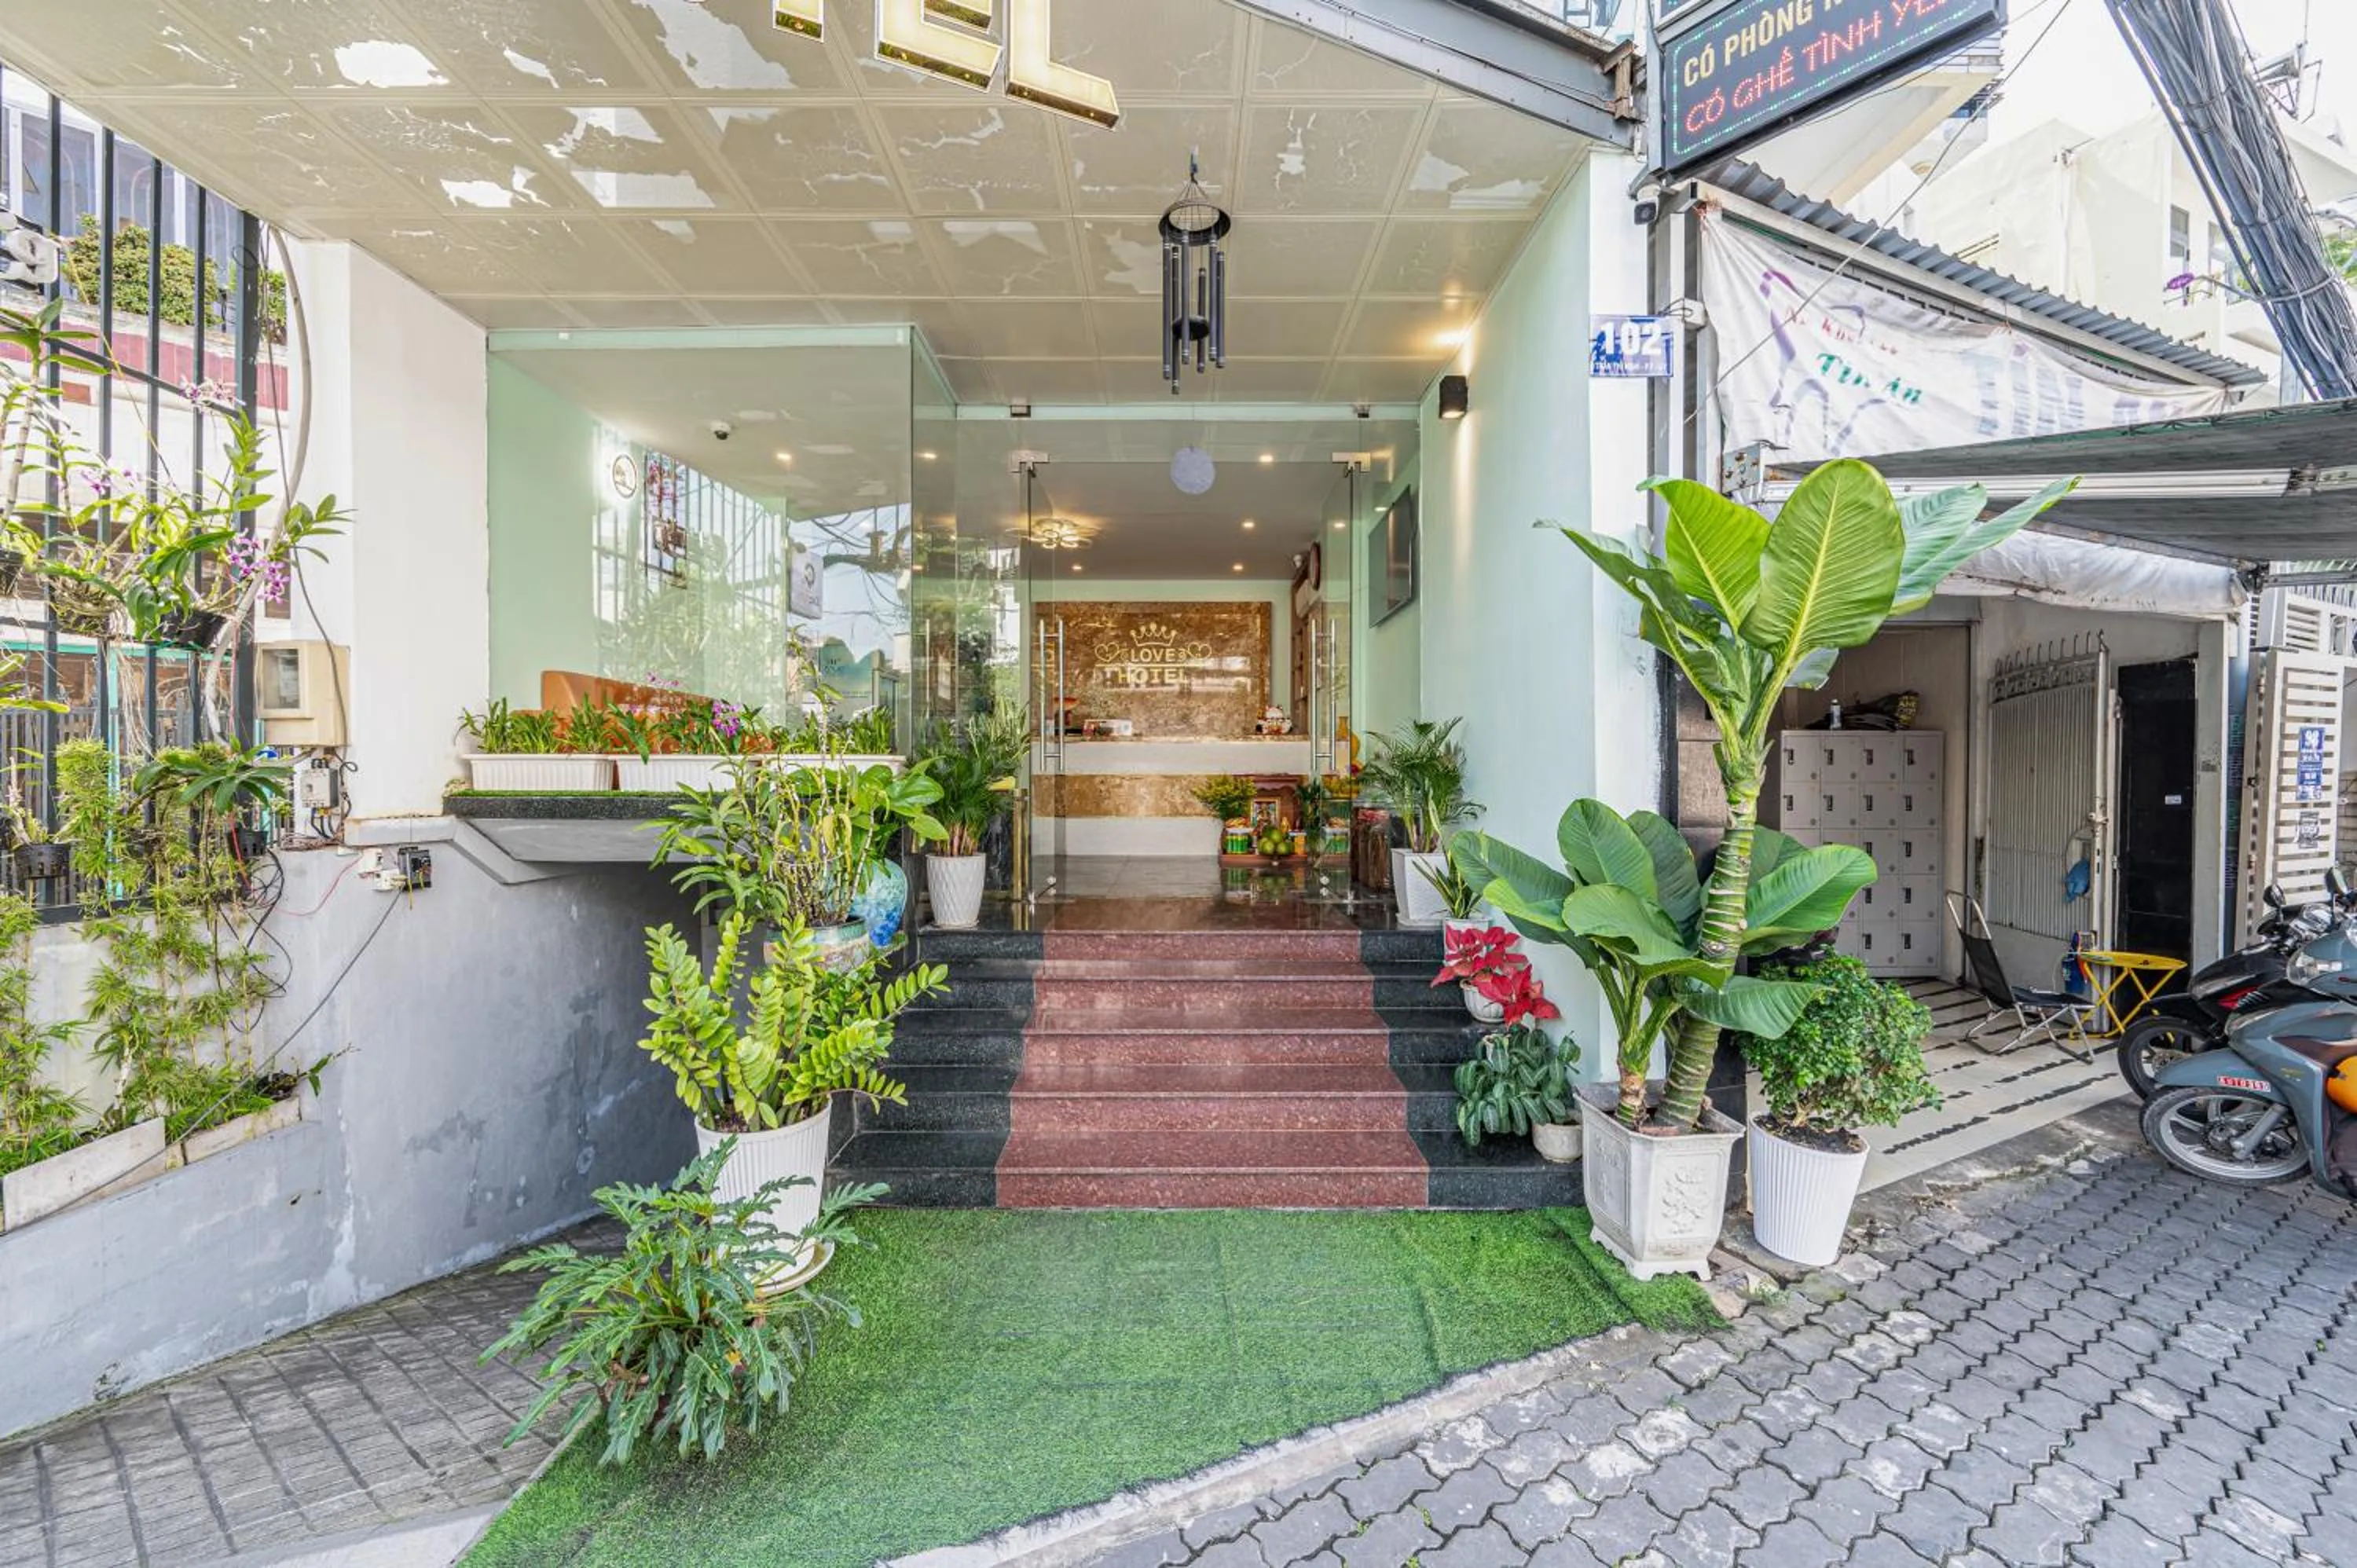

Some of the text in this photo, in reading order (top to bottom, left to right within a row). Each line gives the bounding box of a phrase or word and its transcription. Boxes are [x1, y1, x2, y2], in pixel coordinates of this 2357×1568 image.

[1684, 0, 1813, 87] CÓ PHÒNG
[1686, 86, 1725, 132] CÓ
[1802, 9, 1882, 71] TÌNH
[1600, 321, 1662, 356] 102
[1130, 647, 1176, 663] LOVE
[1117, 668, 1189, 685] HOTEL
